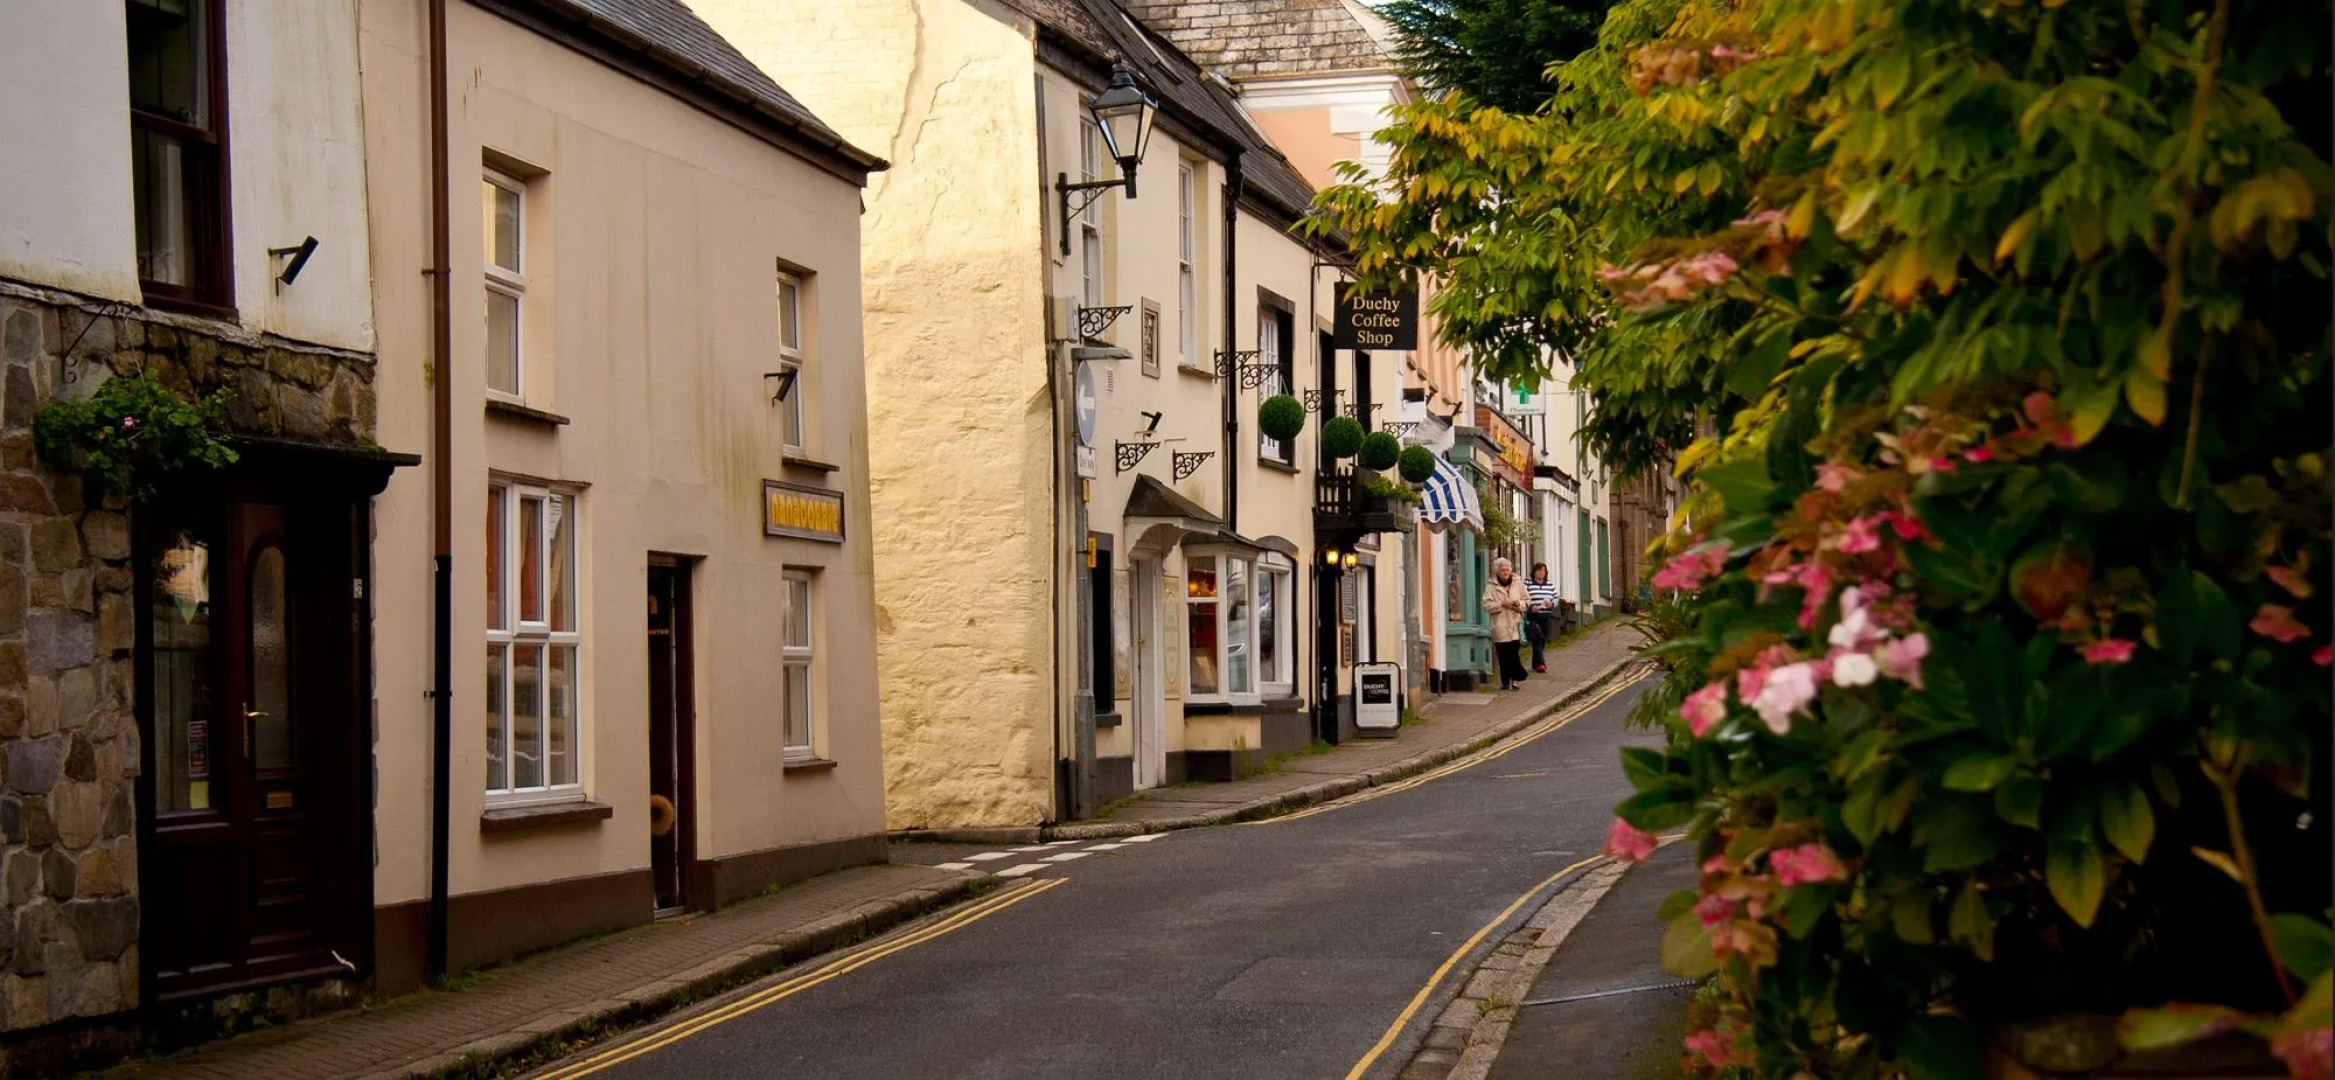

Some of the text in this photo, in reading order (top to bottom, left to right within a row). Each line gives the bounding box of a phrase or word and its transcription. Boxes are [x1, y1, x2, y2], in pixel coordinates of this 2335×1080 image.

[1353, 297, 1400, 313] Duchy
[1352, 313, 1400, 327] Coffee
[1357, 330, 1393, 347] Shop
